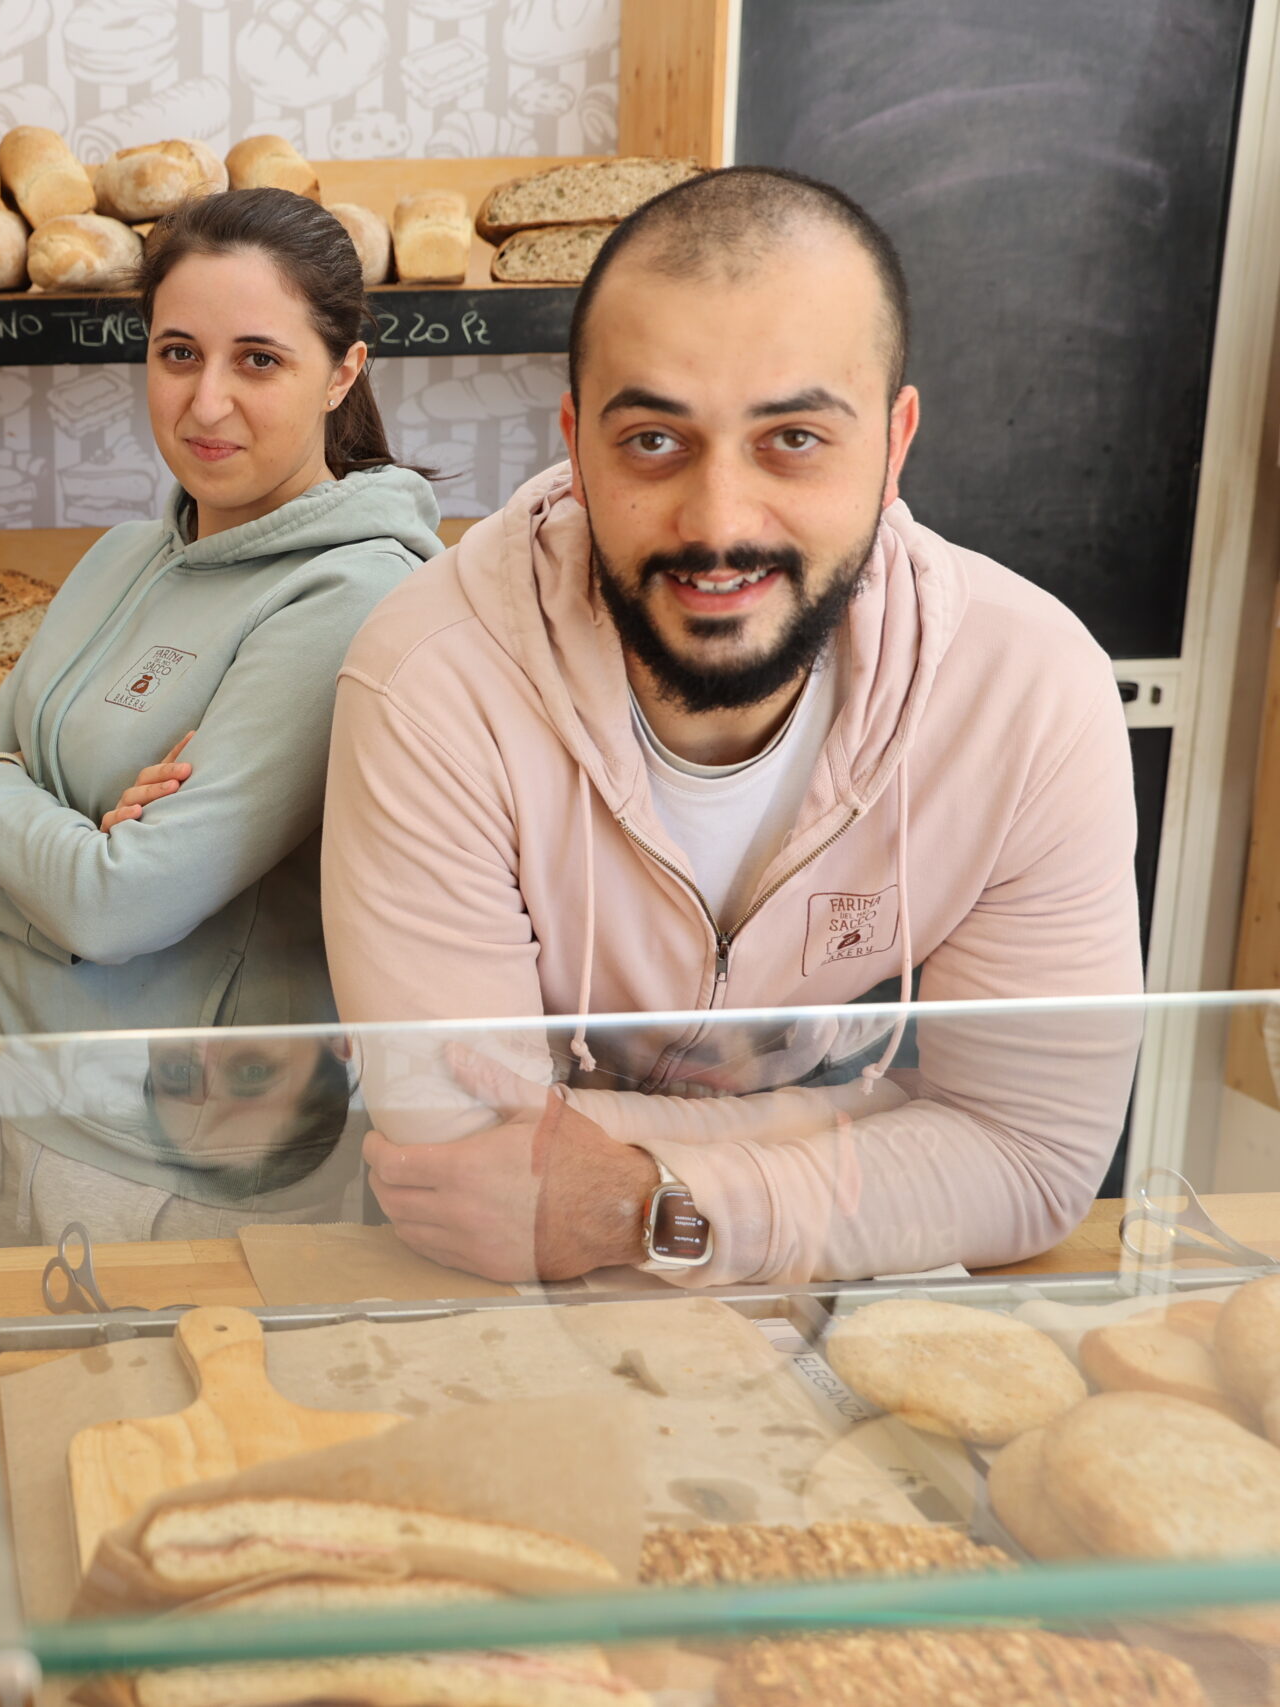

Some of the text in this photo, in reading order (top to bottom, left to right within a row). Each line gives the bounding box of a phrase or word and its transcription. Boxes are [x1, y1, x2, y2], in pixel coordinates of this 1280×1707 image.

[376, 313, 449, 347] 2,20
[461, 310, 491, 345] Pz
[152, 649, 184, 665] FARINA
[142, 661, 172, 676] SACCO
[113, 693, 147, 710] BAKERY
[828, 896, 881, 912] FARINA
[829, 910, 877, 932] SACCO
[793, 1356, 870, 1424] ELEGANZA
